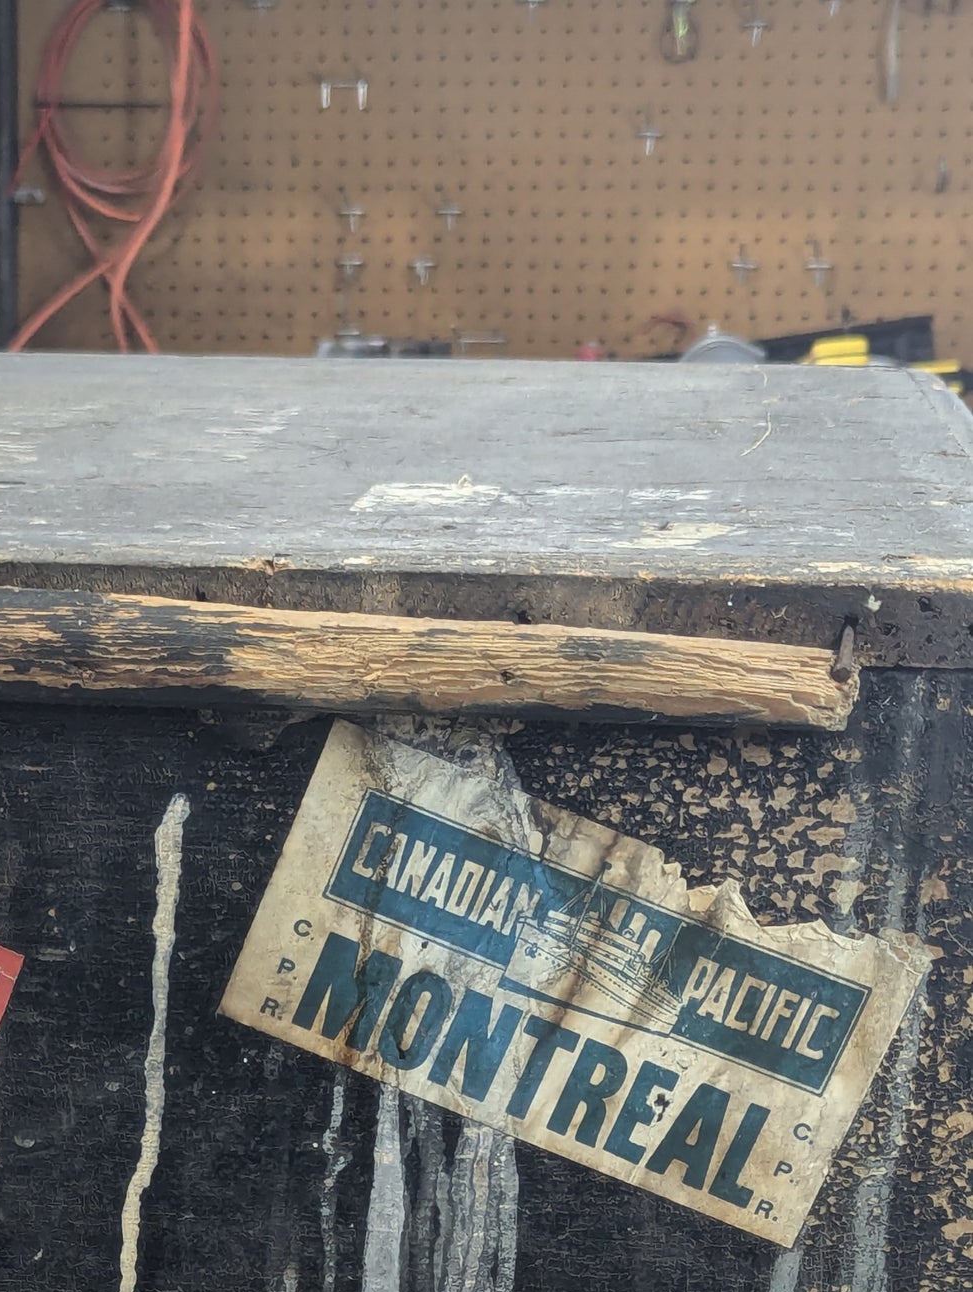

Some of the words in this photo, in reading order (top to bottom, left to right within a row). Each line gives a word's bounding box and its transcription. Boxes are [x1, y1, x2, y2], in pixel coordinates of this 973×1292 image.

[291, 931, 771, 1210] MONTREAL
[352, 821, 543, 936] CANADIAN
[683, 955, 841, 1061] PACIFIC
